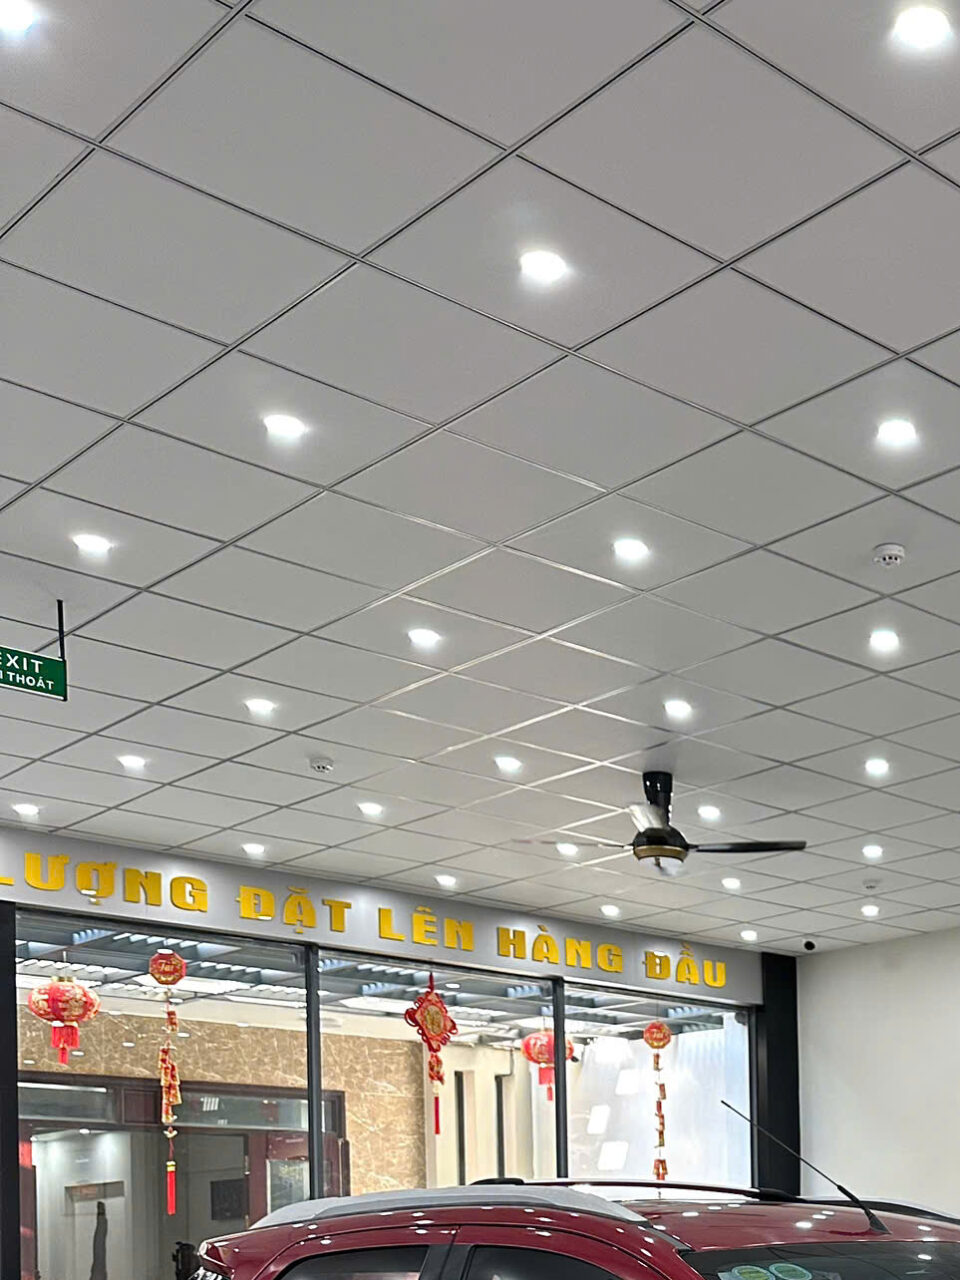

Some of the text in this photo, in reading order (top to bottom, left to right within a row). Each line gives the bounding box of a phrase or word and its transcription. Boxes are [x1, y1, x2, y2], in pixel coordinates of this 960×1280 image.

[0, 652, 43, 673] XIT
[7, 671, 54, 690] THOÁT
[236, 885, 352, 934] ĐẶT
[378, 905, 474, 951] LÊN
[497, 925, 623, 973] HÀNG
[642, 942, 727, 988] ĐẦU
